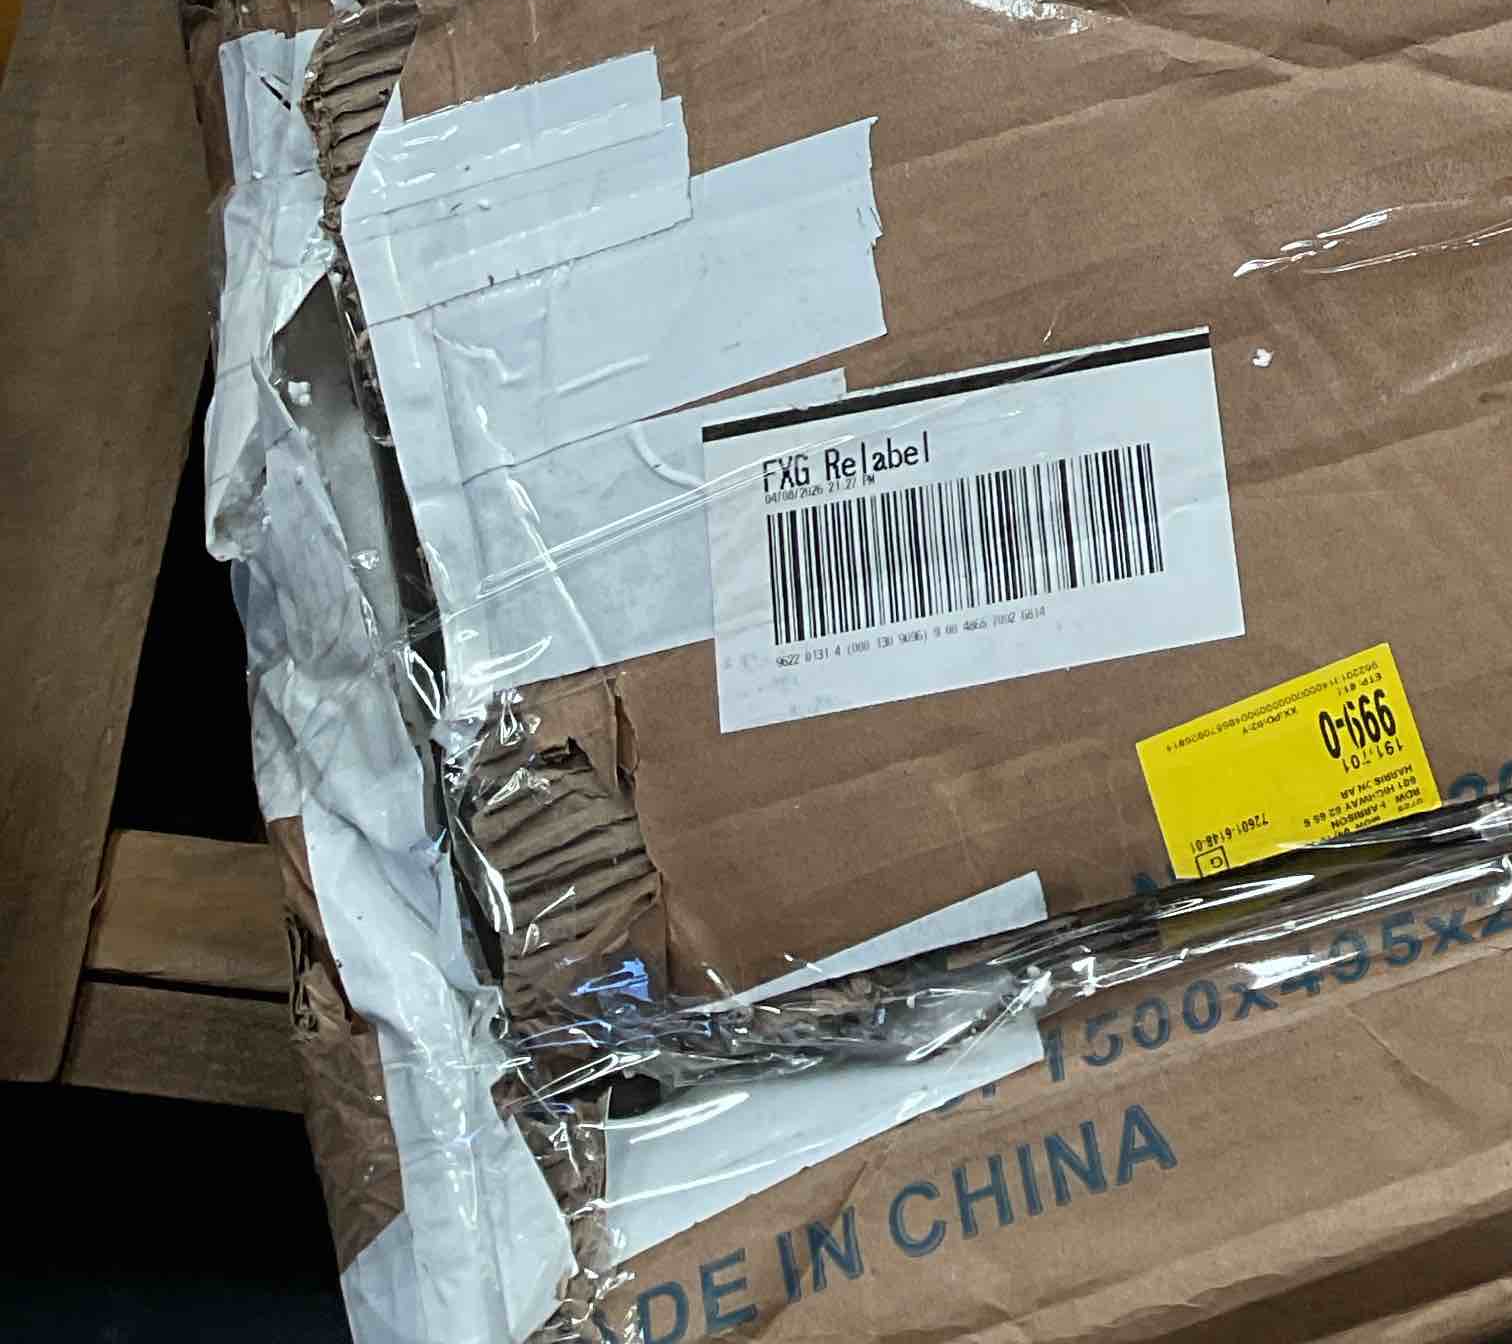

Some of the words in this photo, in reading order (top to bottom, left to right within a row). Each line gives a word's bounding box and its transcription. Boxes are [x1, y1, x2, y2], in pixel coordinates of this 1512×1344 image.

[762, 454, 809, 492] FXG
[825, 430, 930, 481] Relabel
[1318, 688, 1397, 759] 999-0
[1209, 854, 1224, 869] G
[777, 1205, 866, 1303] IN
[888, 1104, 1179, 1258] CHINA
